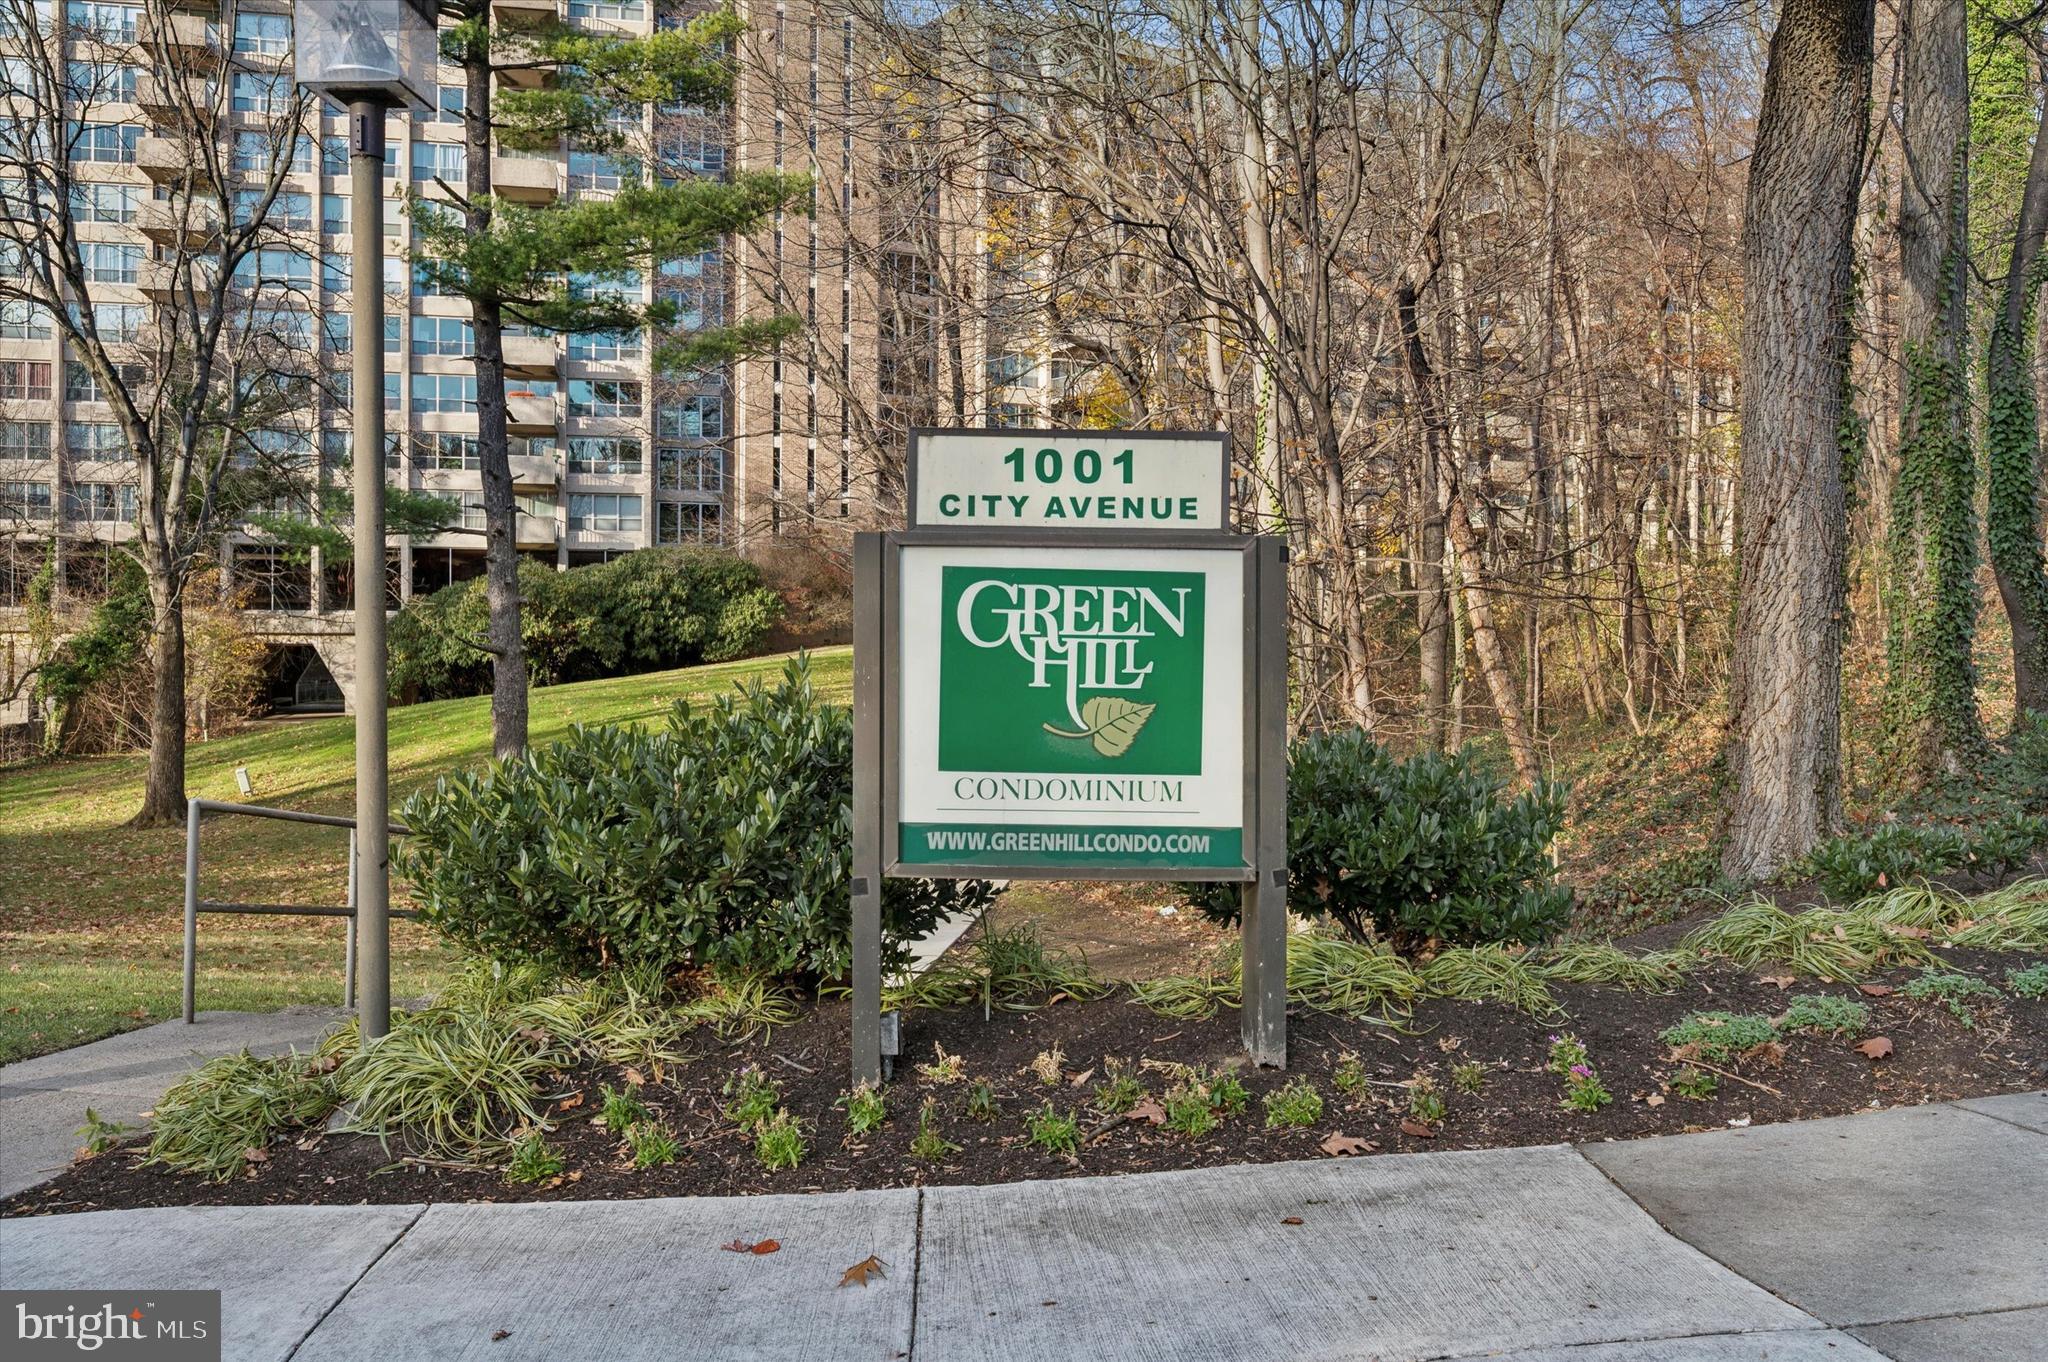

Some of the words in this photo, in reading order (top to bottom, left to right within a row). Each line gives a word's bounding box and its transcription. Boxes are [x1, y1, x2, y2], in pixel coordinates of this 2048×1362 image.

[1003, 447, 1135, 485] 1001
[938, 493, 1031, 519] CITY
[1043, 495, 1200, 521] AVENUE
[956, 579, 1193, 659] GREEN
[1027, 636, 1155, 730] HILL
[953, 776, 1184, 804] CONDOMINIUM
[926, 830, 1212, 855] WWW.GREENHILLCONDO.COM
